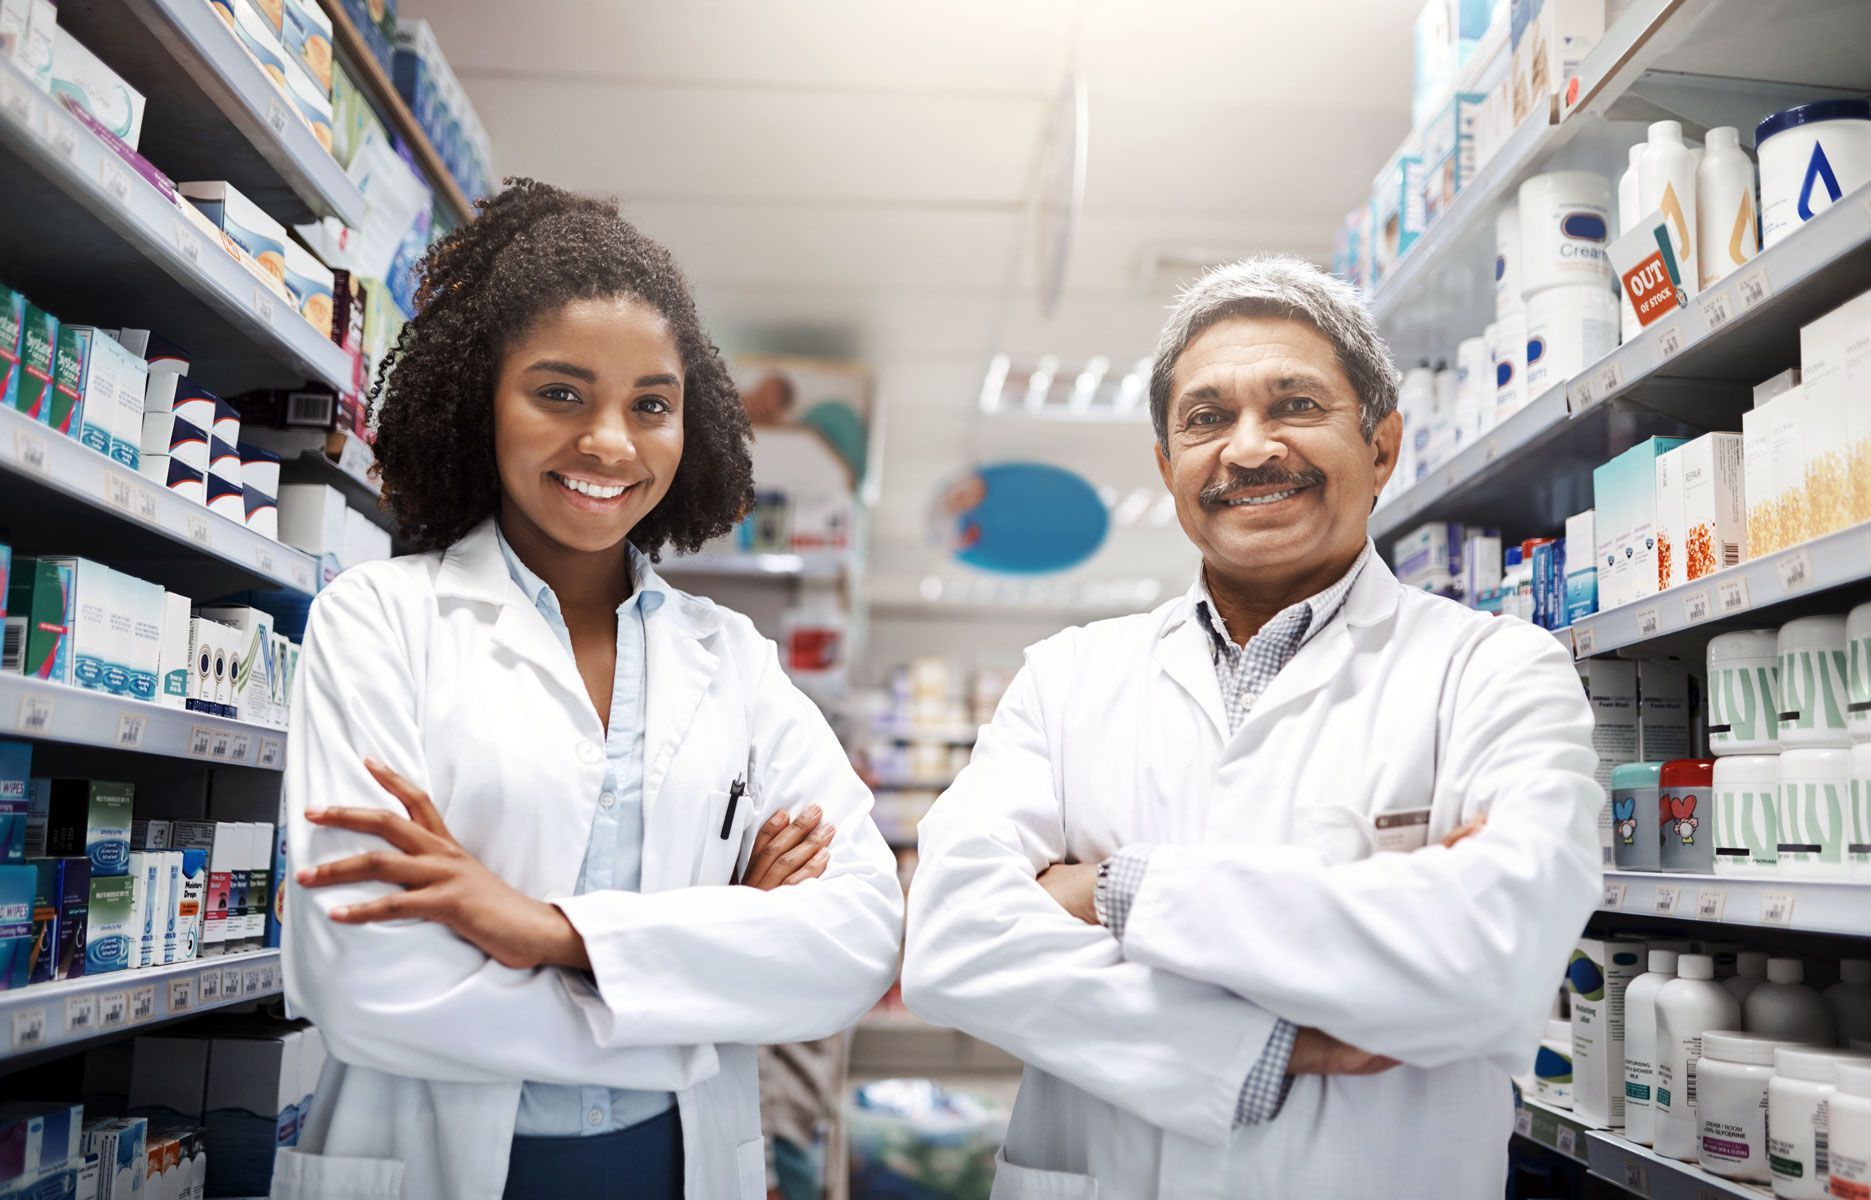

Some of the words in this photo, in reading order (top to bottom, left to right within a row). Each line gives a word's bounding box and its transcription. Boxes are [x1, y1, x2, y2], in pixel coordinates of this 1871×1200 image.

[1630, 259, 1664, 297] OUT
[1640, 301, 1650, 314] OF
[1649, 287, 1672, 308] STOCK
[26, 330, 54, 357] Systane
[58, 349, 82, 373] Systane
[62, 369, 80, 383] ULTRA
[183, 890, 197, 899] Drops
[7, 904, 28, 918] WIPES
[1715, 1129, 1747, 1139] GLYCERINE
